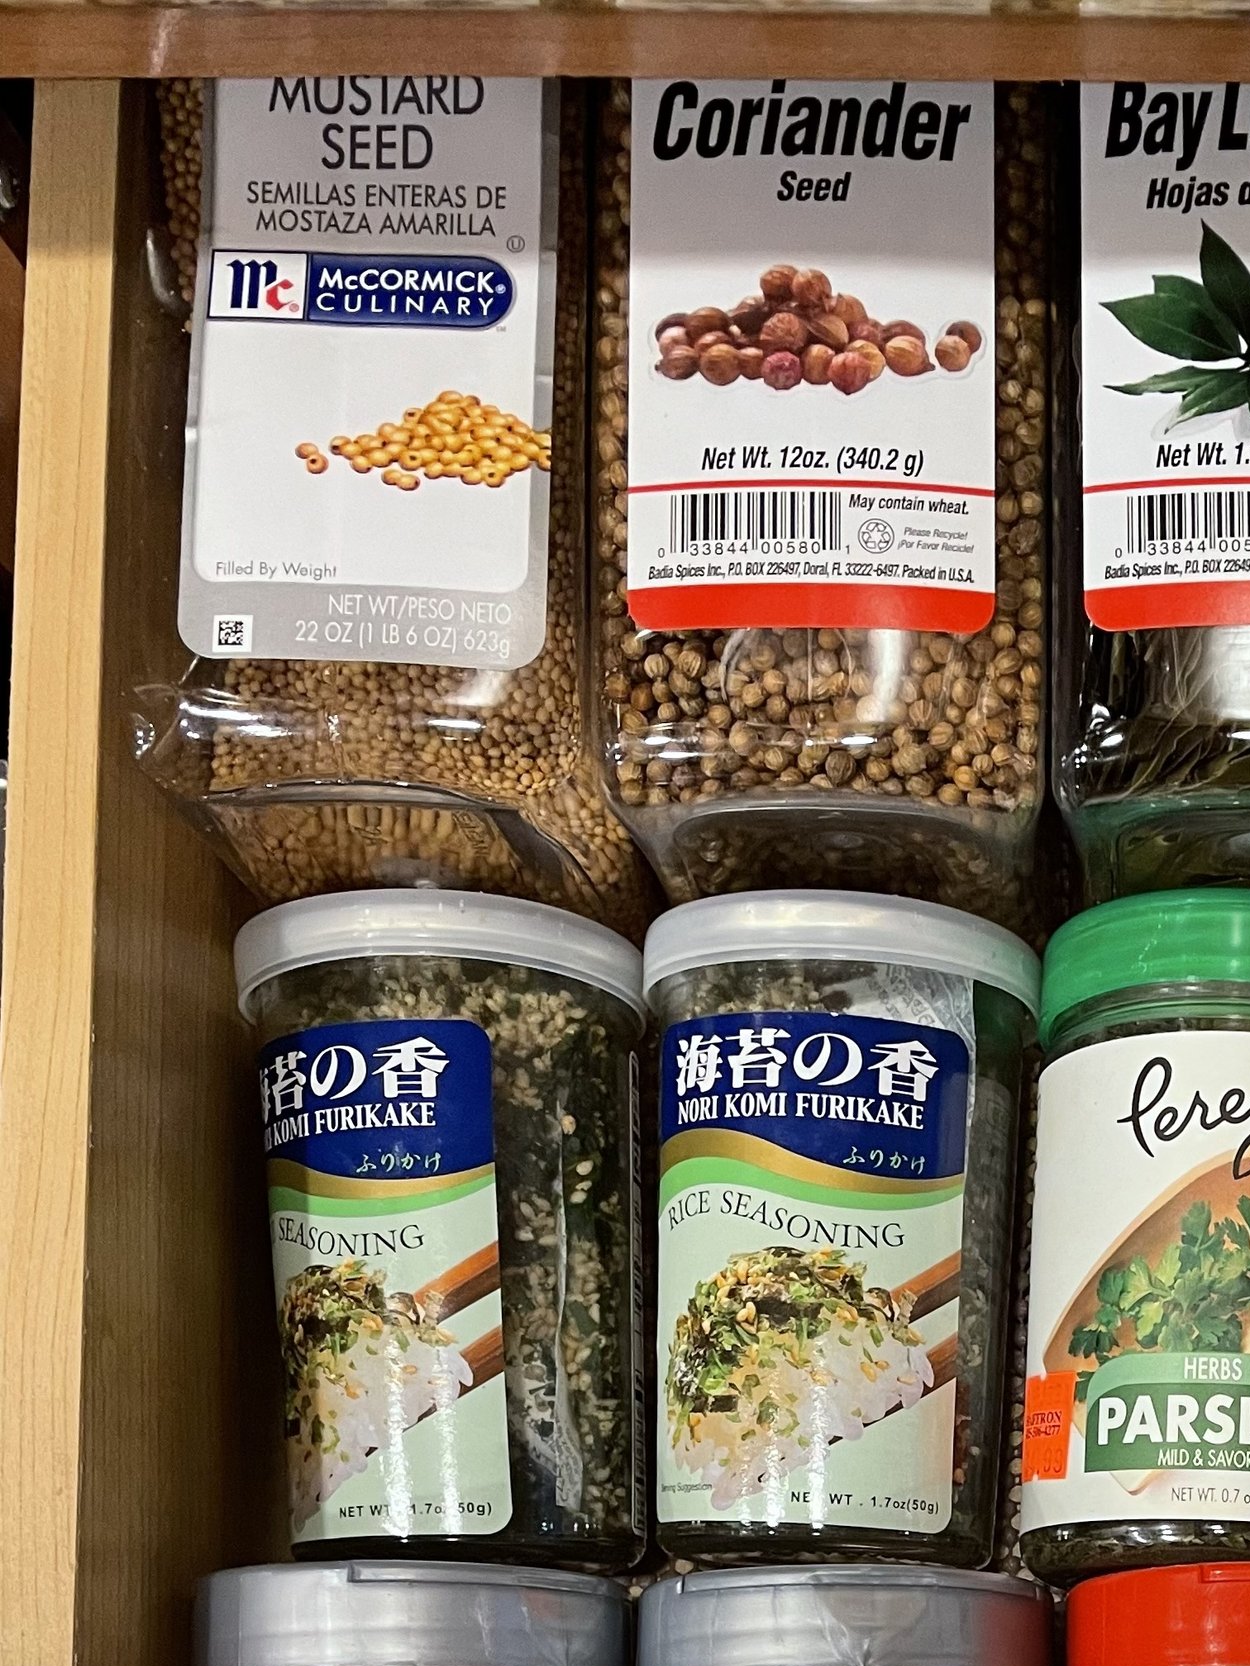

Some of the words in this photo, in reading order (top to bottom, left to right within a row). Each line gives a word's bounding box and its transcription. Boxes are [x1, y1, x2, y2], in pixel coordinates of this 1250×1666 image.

[269, 76, 485, 114] MUSTARD
[653, 80, 971, 161] Coriander
[1105, 81, 1213, 171] Bay
[322, 125, 433, 170] SEED
[248, 181, 355, 207] SEMILLAS
[366, 184, 469, 209] ENTERAS
[476, 187, 506, 209] DE
[777, 171, 851, 202] Seed
[1147, 177, 1229, 214] Hojas
[256, 209, 371, 234] MOSTAZA
[380, 213, 496, 236] AMARILLA
[319, 268, 495, 293] McCORMICK
[316, 293, 494, 317] CULINARY
[702, 447, 736, 472] Net
[742, 447, 772, 470] Wt.
[780, 447, 830, 469] 12oz.
[836, 447, 899, 474] (340.2
[904, 450, 924, 476] g)
[1156, 444, 1191, 468] Net
[1197, 444, 1227, 466] Wt.
[849, 494, 874, 512] May
[879, 496, 923, 513] contain
[927, 498, 969, 516] wheat.
[216, 561, 253, 576] Filled
[259, 563, 277, 579] By
[282, 563, 337, 581] Weight
[649, 565, 674, 579] Badia
[676, 565, 705, 578] Spices
[746, 562, 764, 575] BOX
[832, 563, 842, 575] FL
[902, 565, 935, 579] Packed
[938, 566, 946, 579] in
[675, 1028, 939, 1101] 海苔の香
[274, 1113, 309, 1146] KOMI
[315, 1103, 436, 1134] FURIKAKE
[678, 1093, 717, 1126] NORI
[724, 1091, 786, 1120] KOMI
[795, 1093, 925, 1130] FURIKAKE
[356, 1152, 442, 1175] ふりかけ
[843, 1145, 925, 1174] ふりかけ
[667, 1189, 711, 1232] RICE
[720, 1191, 905, 1249] SEASONING
[278, 1218, 425, 1257] SEASONING
[1184, 1357, 1242, 1381] HERBS
[1158, 1449, 1189, 1466] MILD
[1193, 1450, 1203, 1466] &
[1172, 1487, 1194, 1502] NET
[1197, 1488, 1217, 1504] WT.
[1222, 1488, 1240, 1504] 0.7
